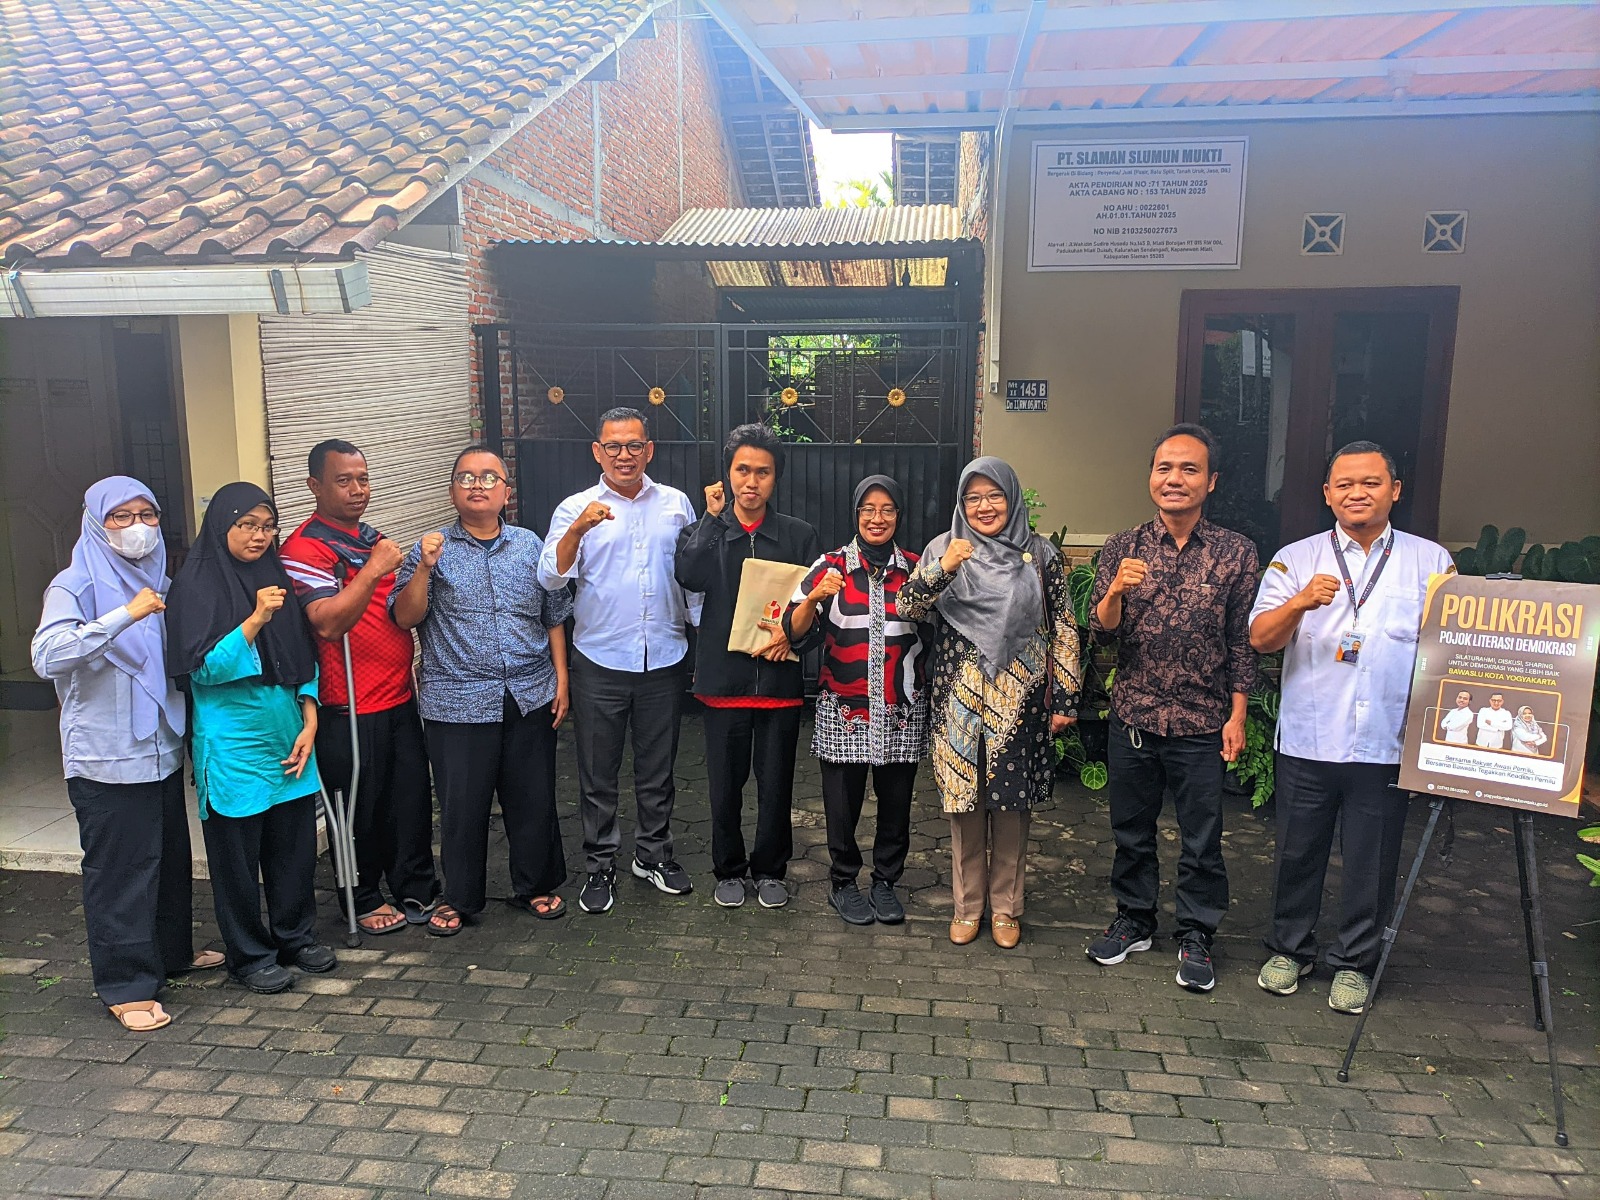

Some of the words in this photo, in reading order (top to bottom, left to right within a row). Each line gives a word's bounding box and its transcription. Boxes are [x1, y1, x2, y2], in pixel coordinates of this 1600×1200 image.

[1057, 152, 1074, 166] PT.
[1076, 150, 1126, 165] SLAMAN
[1128, 150, 1180, 164] SLUMUN
[1182, 148, 1222, 163] MUKTI
[1020, 382, 1037, 396] 145
[1039, 383, 1046, 396] B
[1440, 594, 1584, 640] POLIKRASI
[1439, 630, 1472, 646] POJOK
[1472, 634, 1514, 651] LITERASI
[1515, 638, 1576, 656] DEMOKRASI
[1455, 654, 1496, 664] SILATURAHMI,
[1498, 659, 1524, 667] DISKUSI,
[1525, 661, 1554, 670] SHARING
[1470, 662, 1506, 671] DEMOKRASI
[1448, 668, 1484, 678] BAWASLU
[1506, 674, 1557, 686] YOGYAKARTA
[1445, 755, 1471, 764] Bersama
[1472, 758, 1493, 768] Rakyat
[1493, 762, 1512, 770] Awasi
[1425, 760, 1451, 768] Bersama
[1478, 767, 1506, 777] Tegakkan
[1534, 776, 1556, 785] Pemilu
